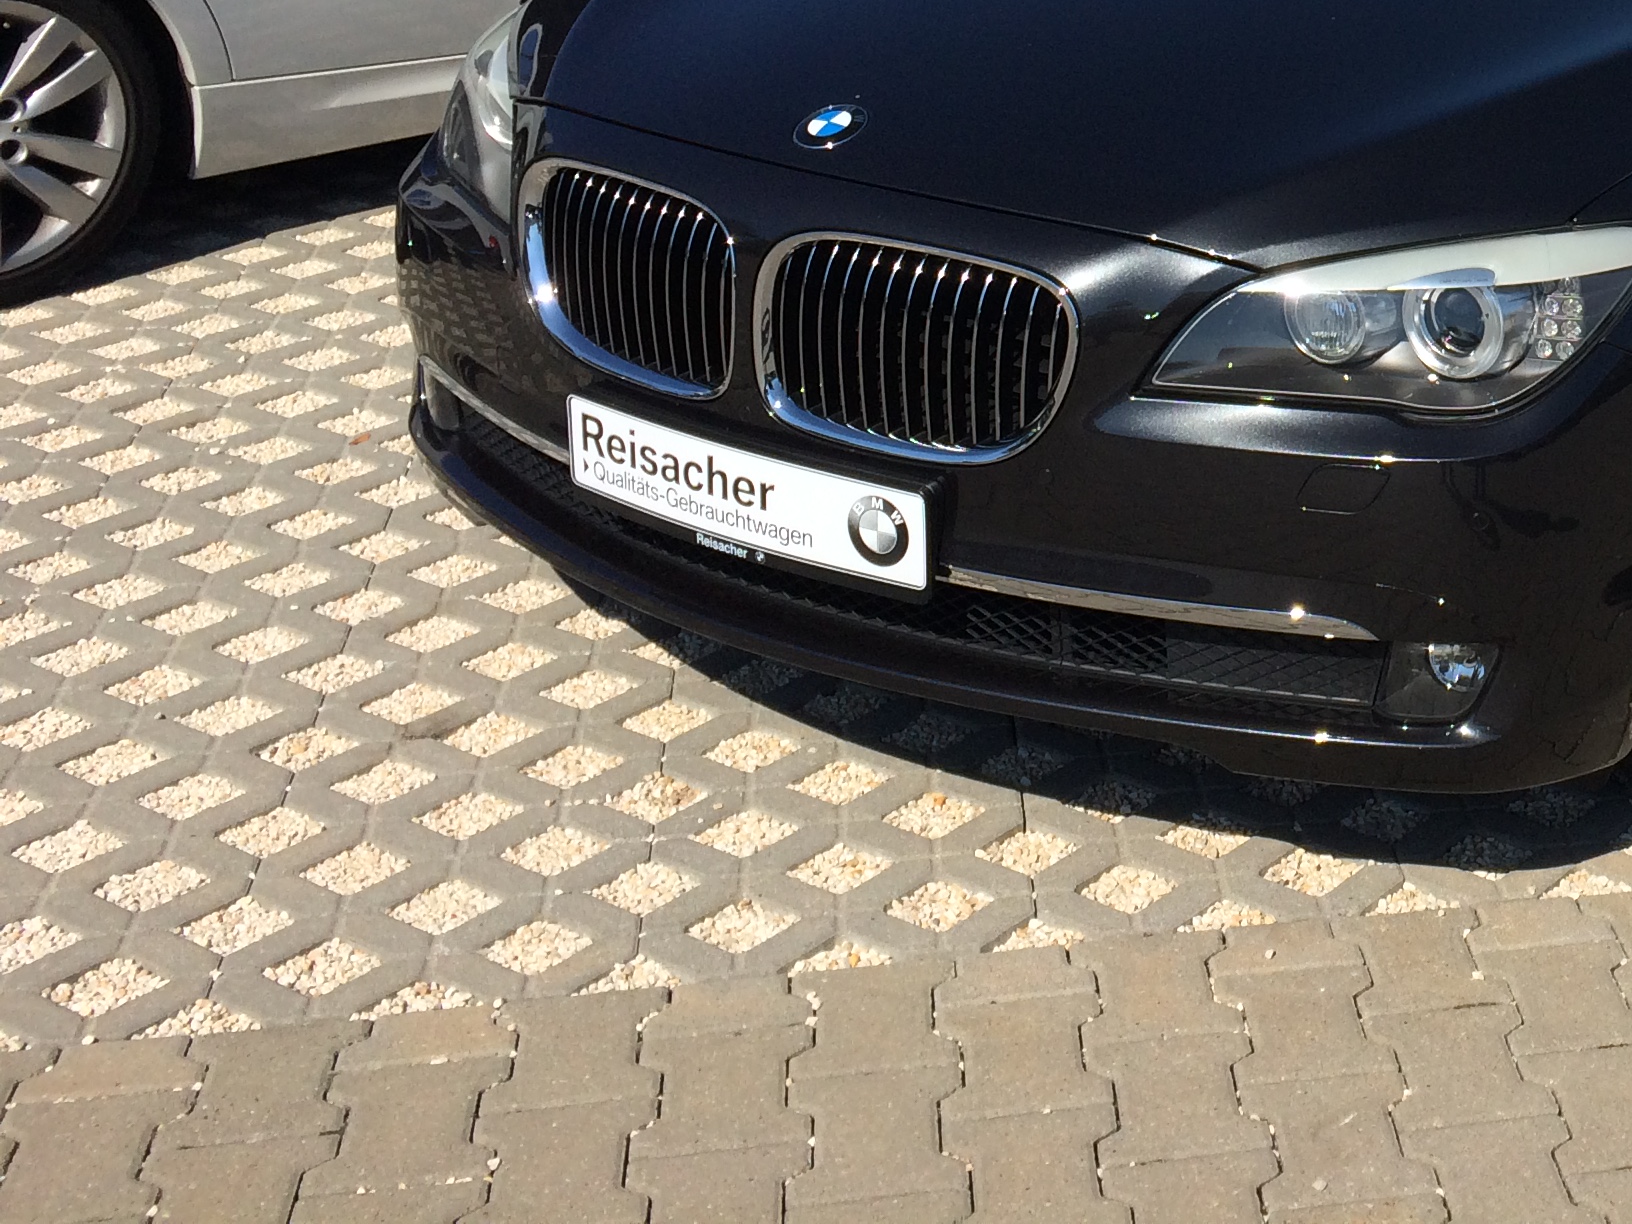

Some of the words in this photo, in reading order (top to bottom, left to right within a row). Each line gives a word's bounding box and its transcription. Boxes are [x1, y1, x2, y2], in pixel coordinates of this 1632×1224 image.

[581, 413, 775, 512] Reisacher
[593, 460, 813, 549] Qualitäts-Gebrauchtwagen
[853, 496, 904, 526] BMW
[696, 532, 748, 560] Reisacher
